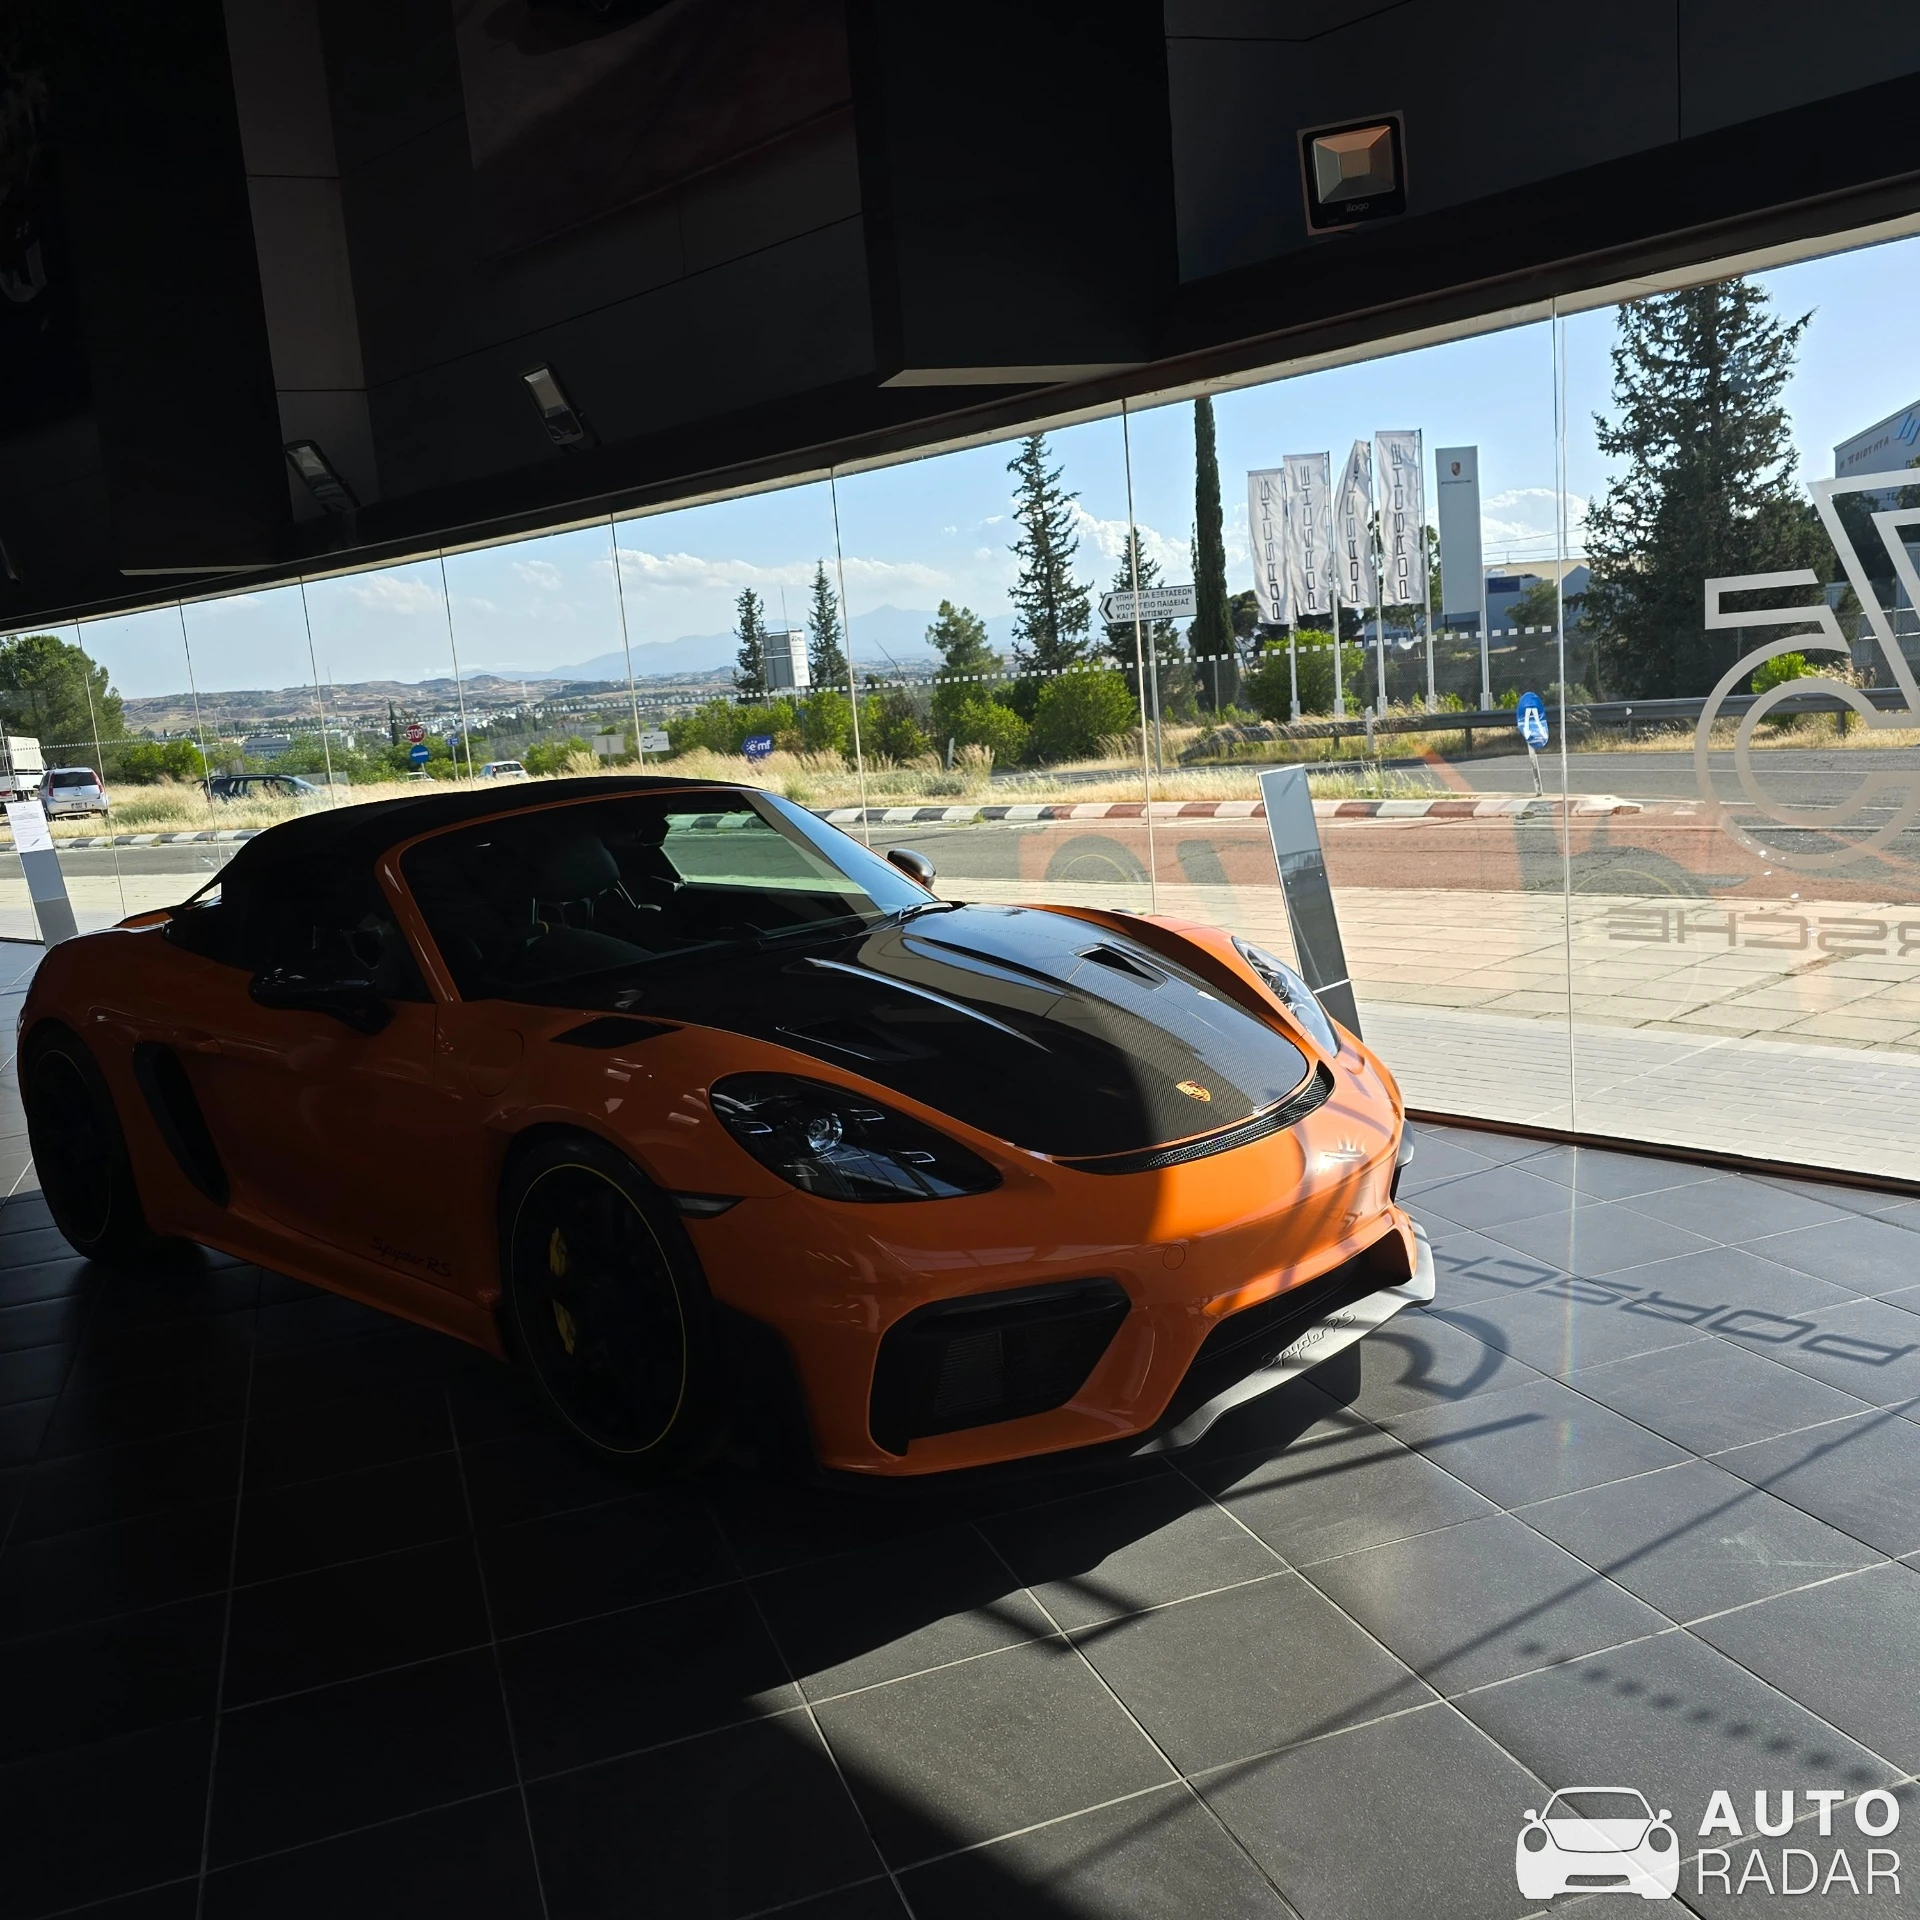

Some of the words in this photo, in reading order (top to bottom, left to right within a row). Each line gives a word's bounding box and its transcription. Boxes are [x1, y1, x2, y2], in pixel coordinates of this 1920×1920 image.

[1300, 464, 1318, 611] PORSCHE
[1392, 443, 1410, 600] PORSCHE
[1260, 480, 1281, 621] PORSCHE
[1115, 593, 1150, 602] ΥΠΗΡΣΙΑ
[1152, 588, 1192, 598] ΕΞΕΤΑΣΕΩΝ
[1116, 602, 1155, 611] ΥΠΟΥΓΕΙΟ
[1157, 599, 1189, 607] ΠΑΙΔΕΙΑΣ
[1130, 609, 1173, 619] ΠΛΙΤΙΣΜΟΥ
[406, 728, 424, 740] STOP
[368, 1235, 424, 1264] Spyder
[426, 1256, 452, 1277] RS
[1259, 1327, 1327, 1372] Spyder
[1325, 1310, 1357, 1333] RS
